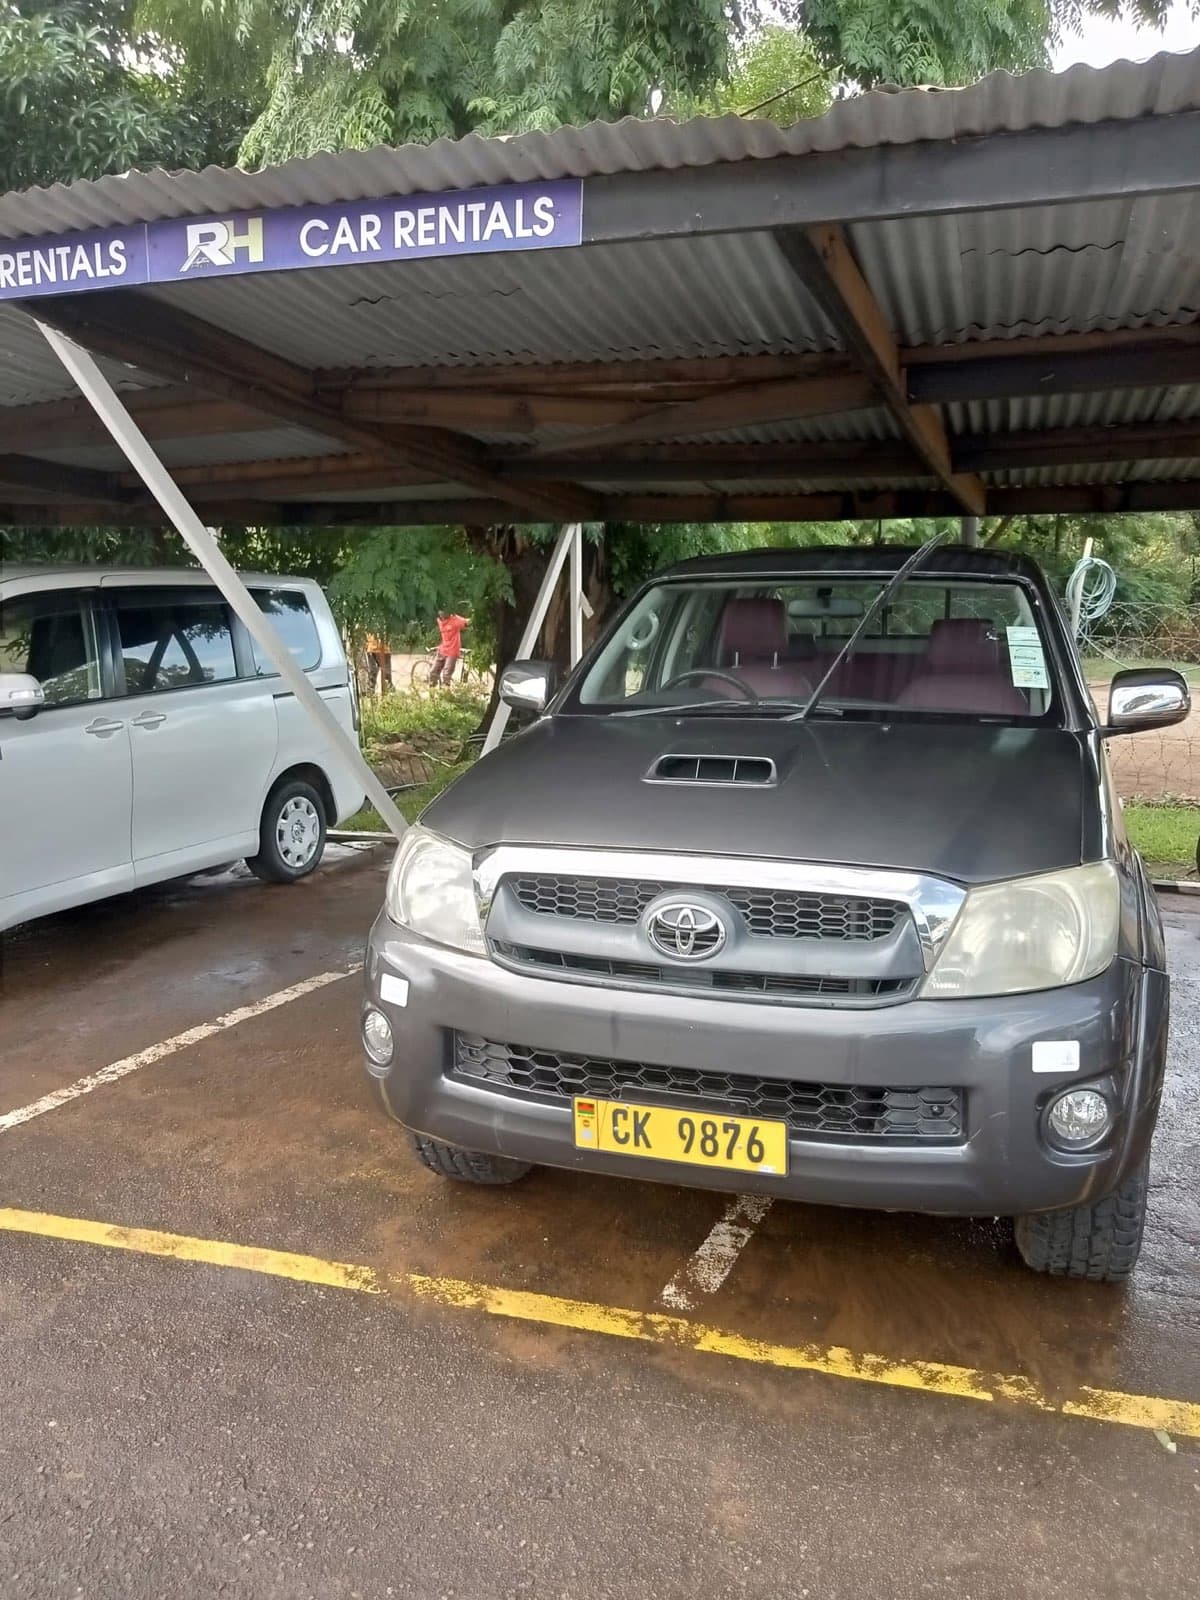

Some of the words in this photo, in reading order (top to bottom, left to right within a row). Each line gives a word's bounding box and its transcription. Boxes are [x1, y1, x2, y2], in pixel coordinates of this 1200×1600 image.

[180, 217, 264, 272] RH
[299, 214, 382, 257] CAR
[394, 196, 555, 249] RENTALS
[0, 240, 127, 288] RENTALS
[612, 1108, 653, 1149] CK
[678, 1117, 765, 1163] 9876
